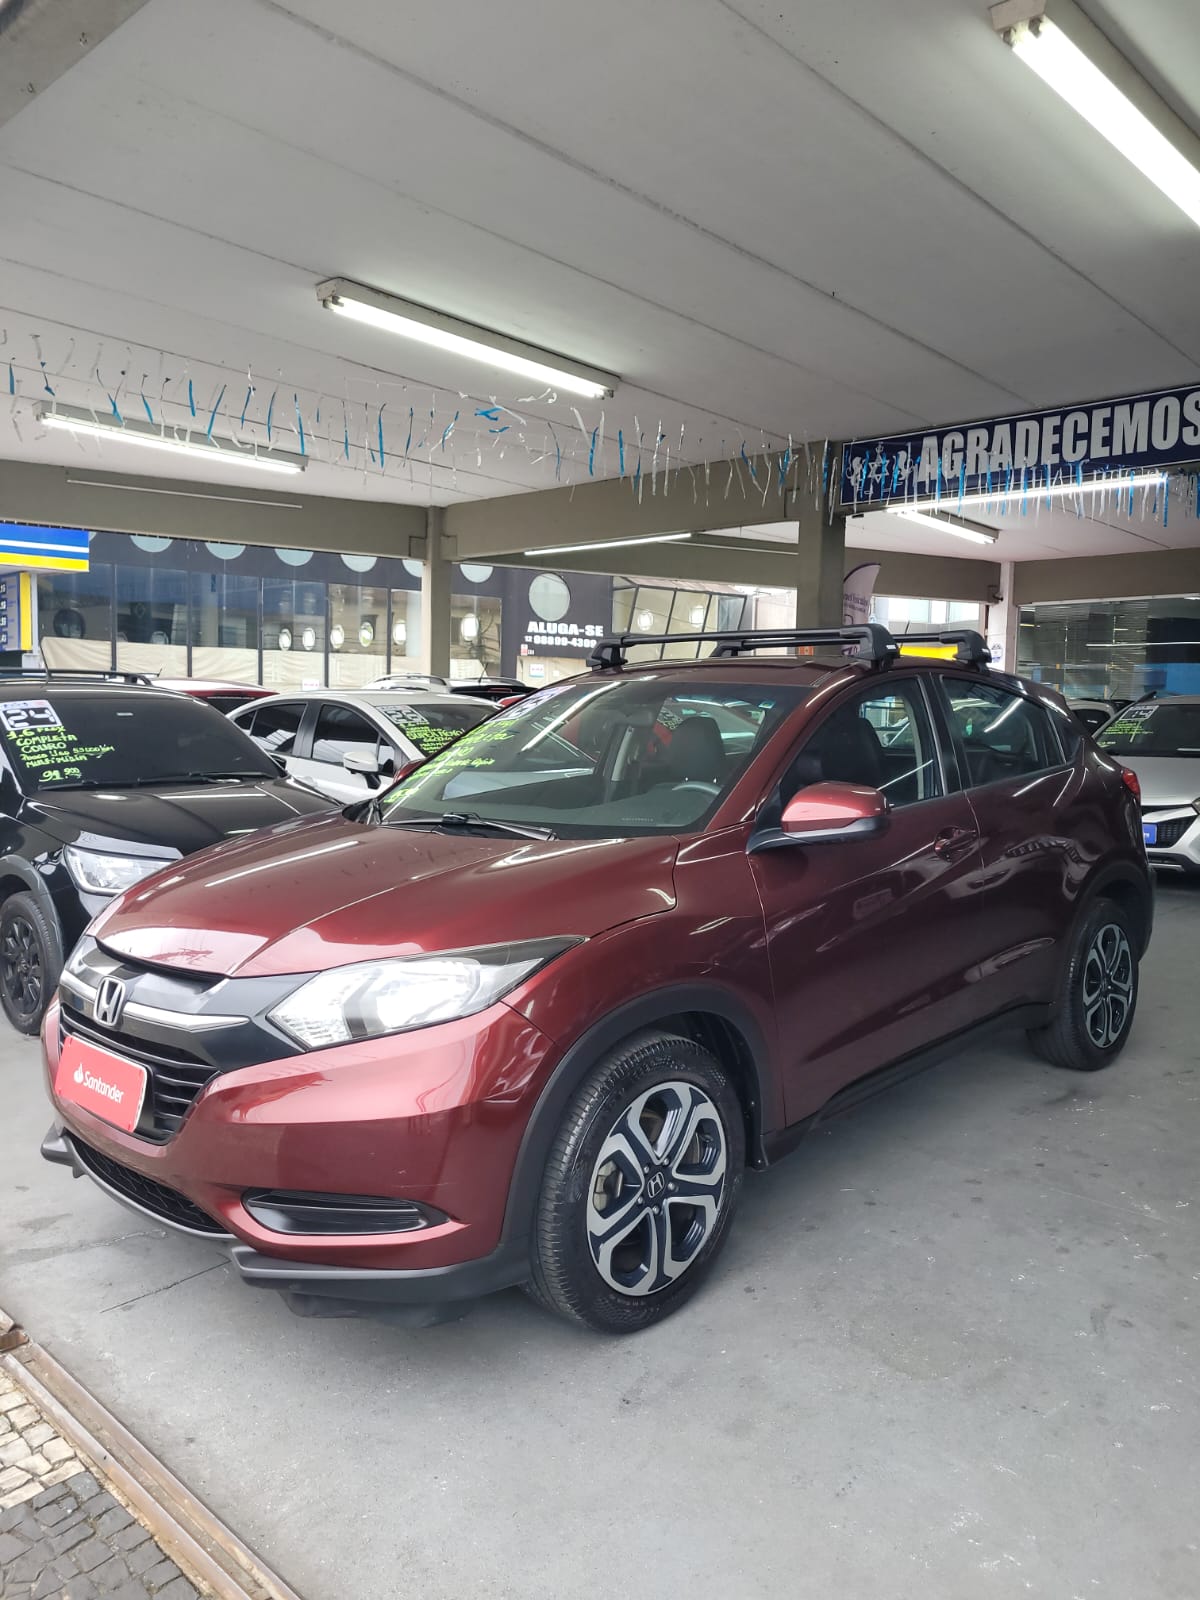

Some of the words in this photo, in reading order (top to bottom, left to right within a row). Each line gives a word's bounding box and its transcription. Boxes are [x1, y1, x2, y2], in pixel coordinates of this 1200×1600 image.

[917, 390, 1200, 483] AGRADECEMOS
[527, 621, 604, 637] ALUGA-SE
[6, 709, 55, 728] 24
[21, 742, 67, 754] COURO
[83, 1071, 125, 1104] Santander
